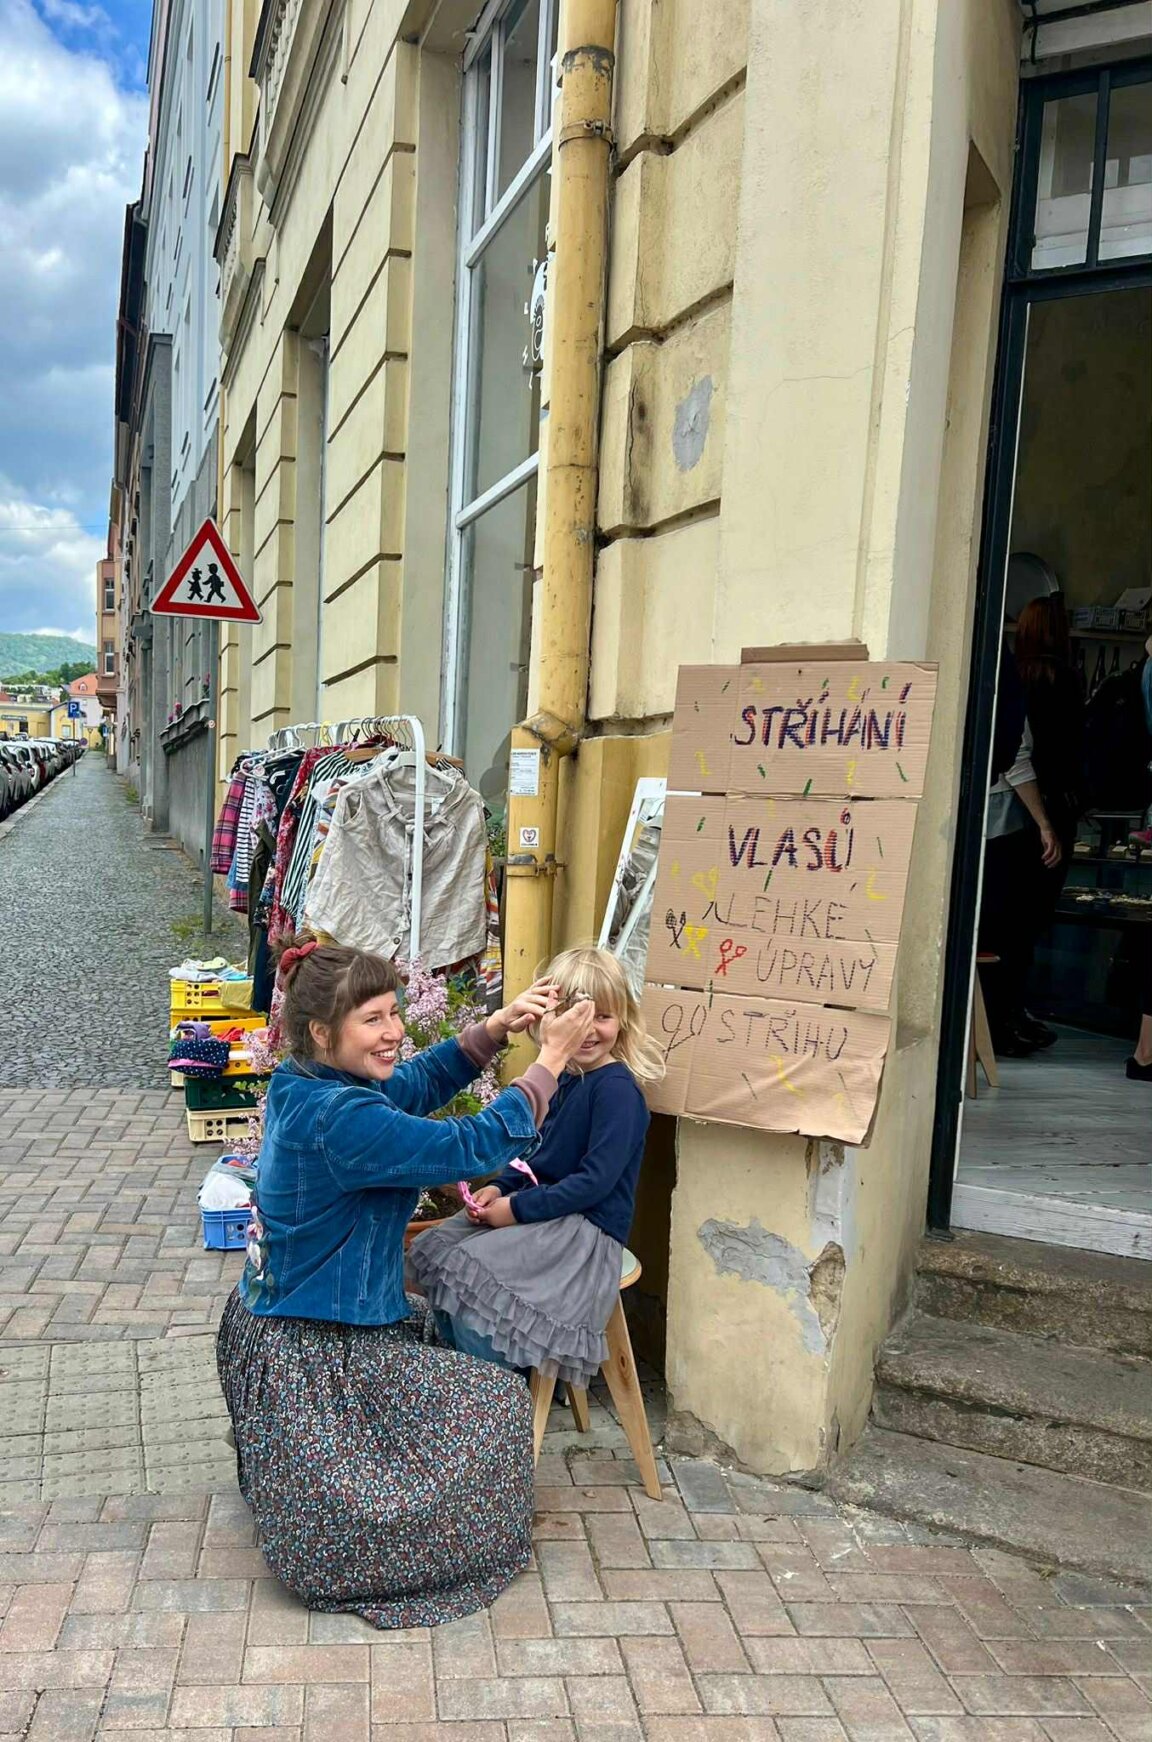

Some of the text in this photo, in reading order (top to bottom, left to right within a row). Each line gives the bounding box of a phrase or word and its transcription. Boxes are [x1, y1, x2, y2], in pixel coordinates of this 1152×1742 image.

[70, 703, 77, 713] P
[734, 682, 912, 752] STŘÍHÁNÍ
[729, 807, 854, 872] VLASŮ
